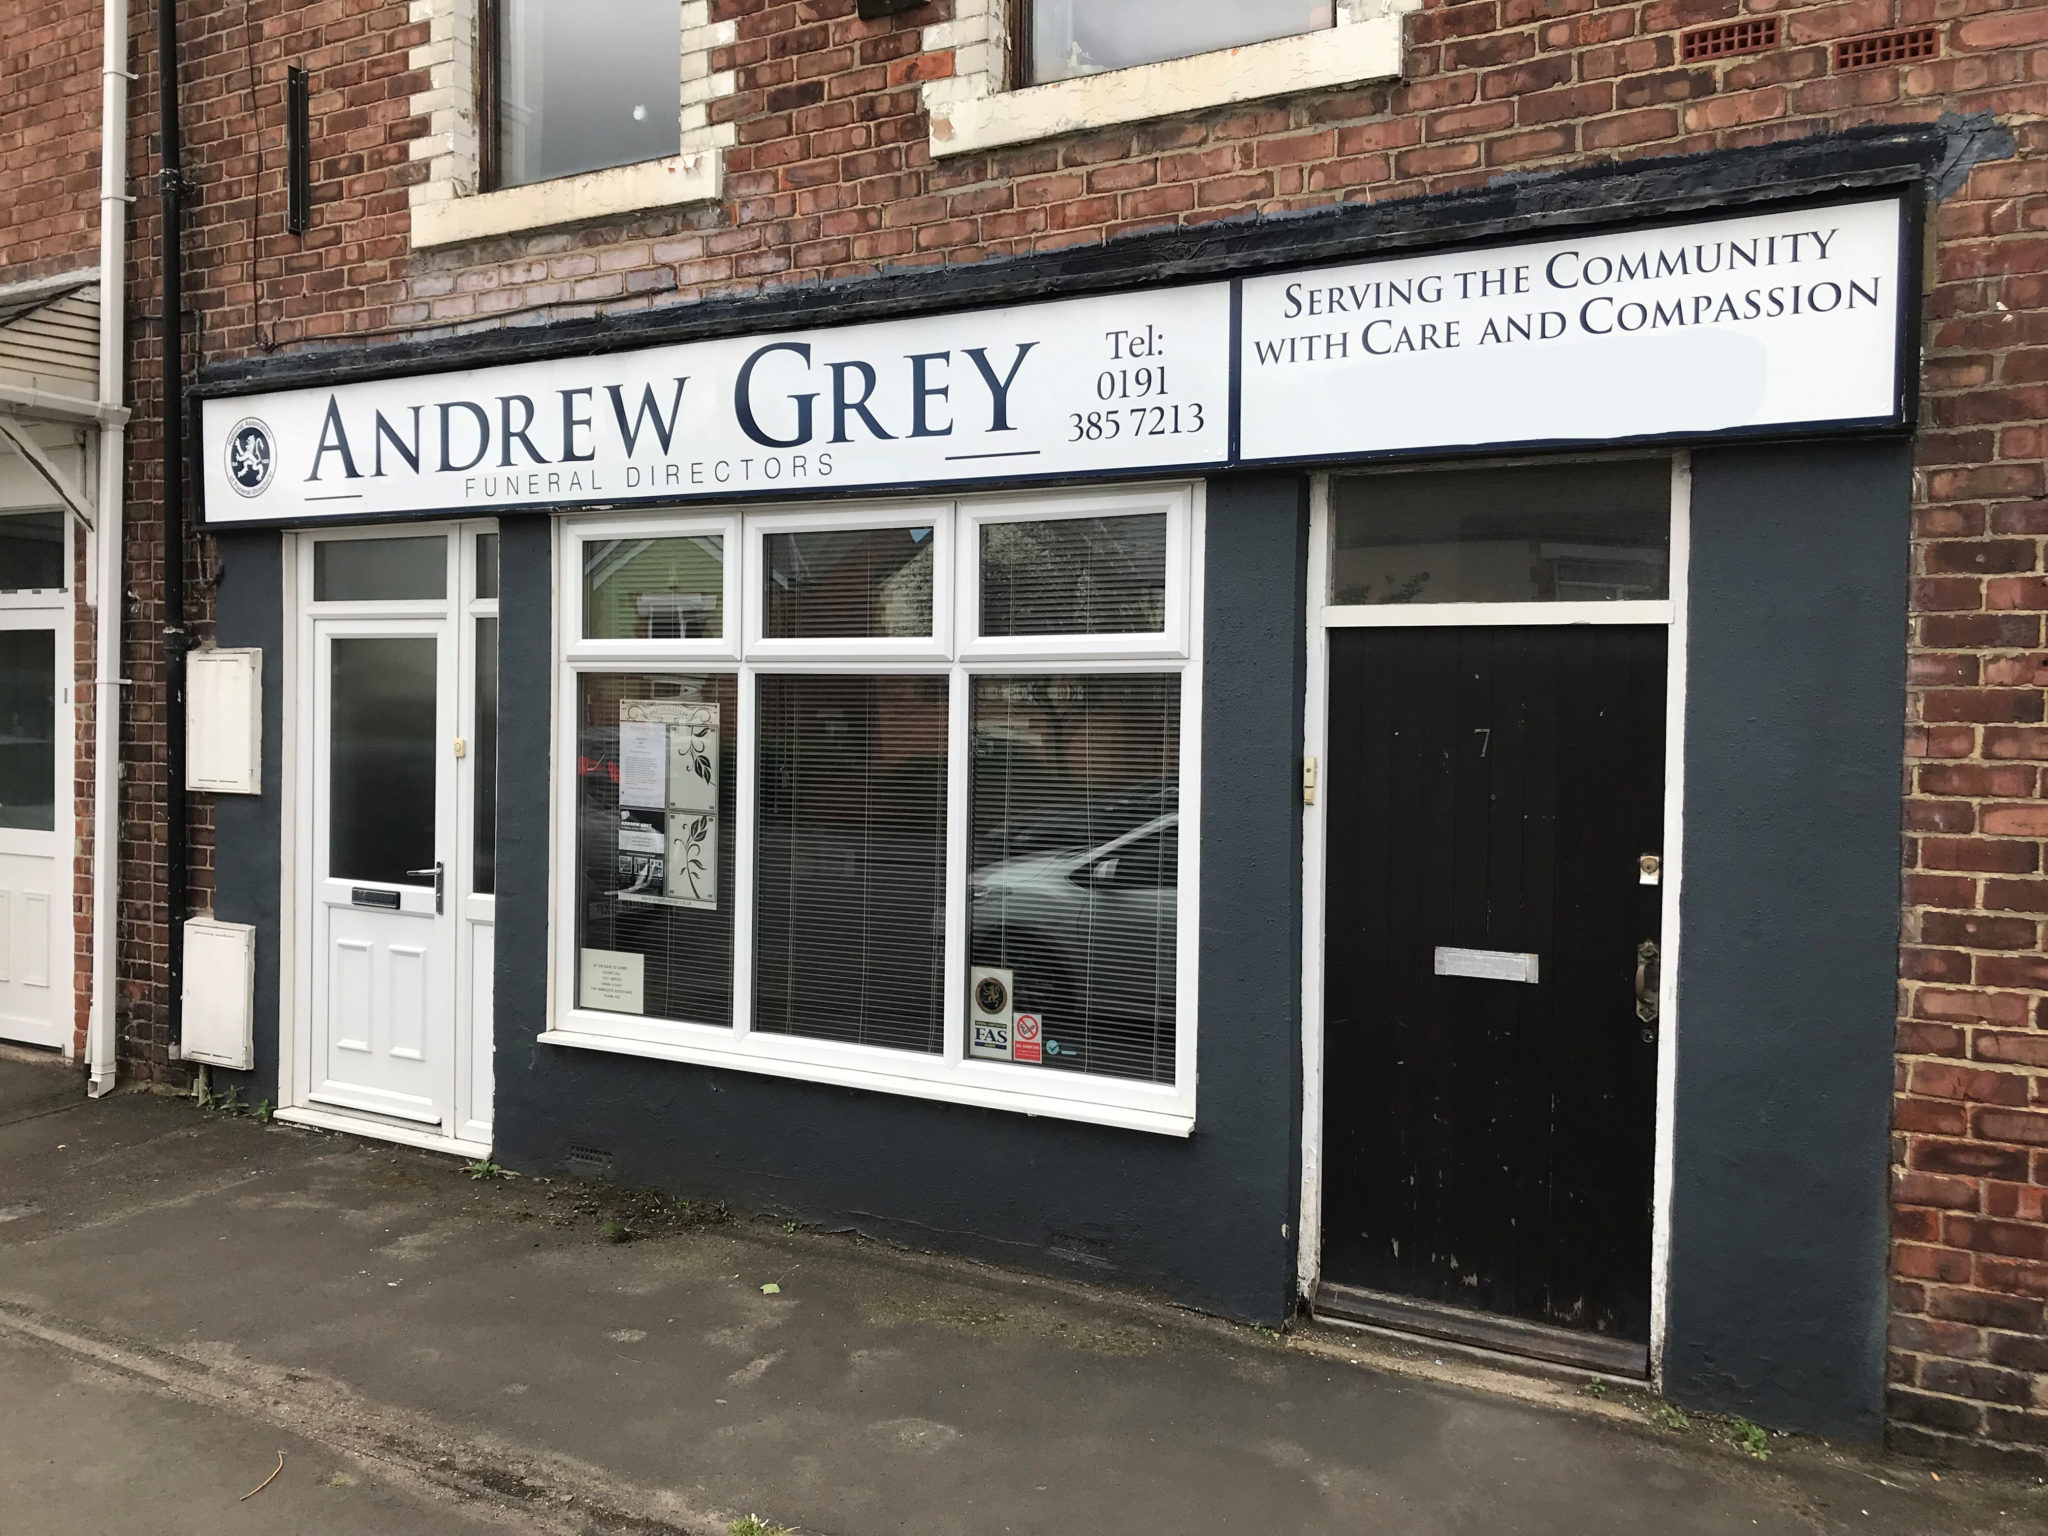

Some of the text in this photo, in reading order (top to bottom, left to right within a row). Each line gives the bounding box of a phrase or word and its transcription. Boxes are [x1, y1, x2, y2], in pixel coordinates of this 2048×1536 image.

[1284, 228, 1839, 319] SERVING THE COMMUNITY
[1254, 277, 1880, 366] WITH CARE AND COMPASSION
[1105, 325, 1164, 360] Tel:
[1096, 366, 1168, 400] 0191
[303, 341, 1041, 482] ANDREW GREY
[1067, 403, 1205, 443] 385 7213
[465, 453, 834, 498] FUNERAL DIRECTORS
[1474, 728, 1491, 758] 7
[974, 1027, 1008, 1044] FAS
